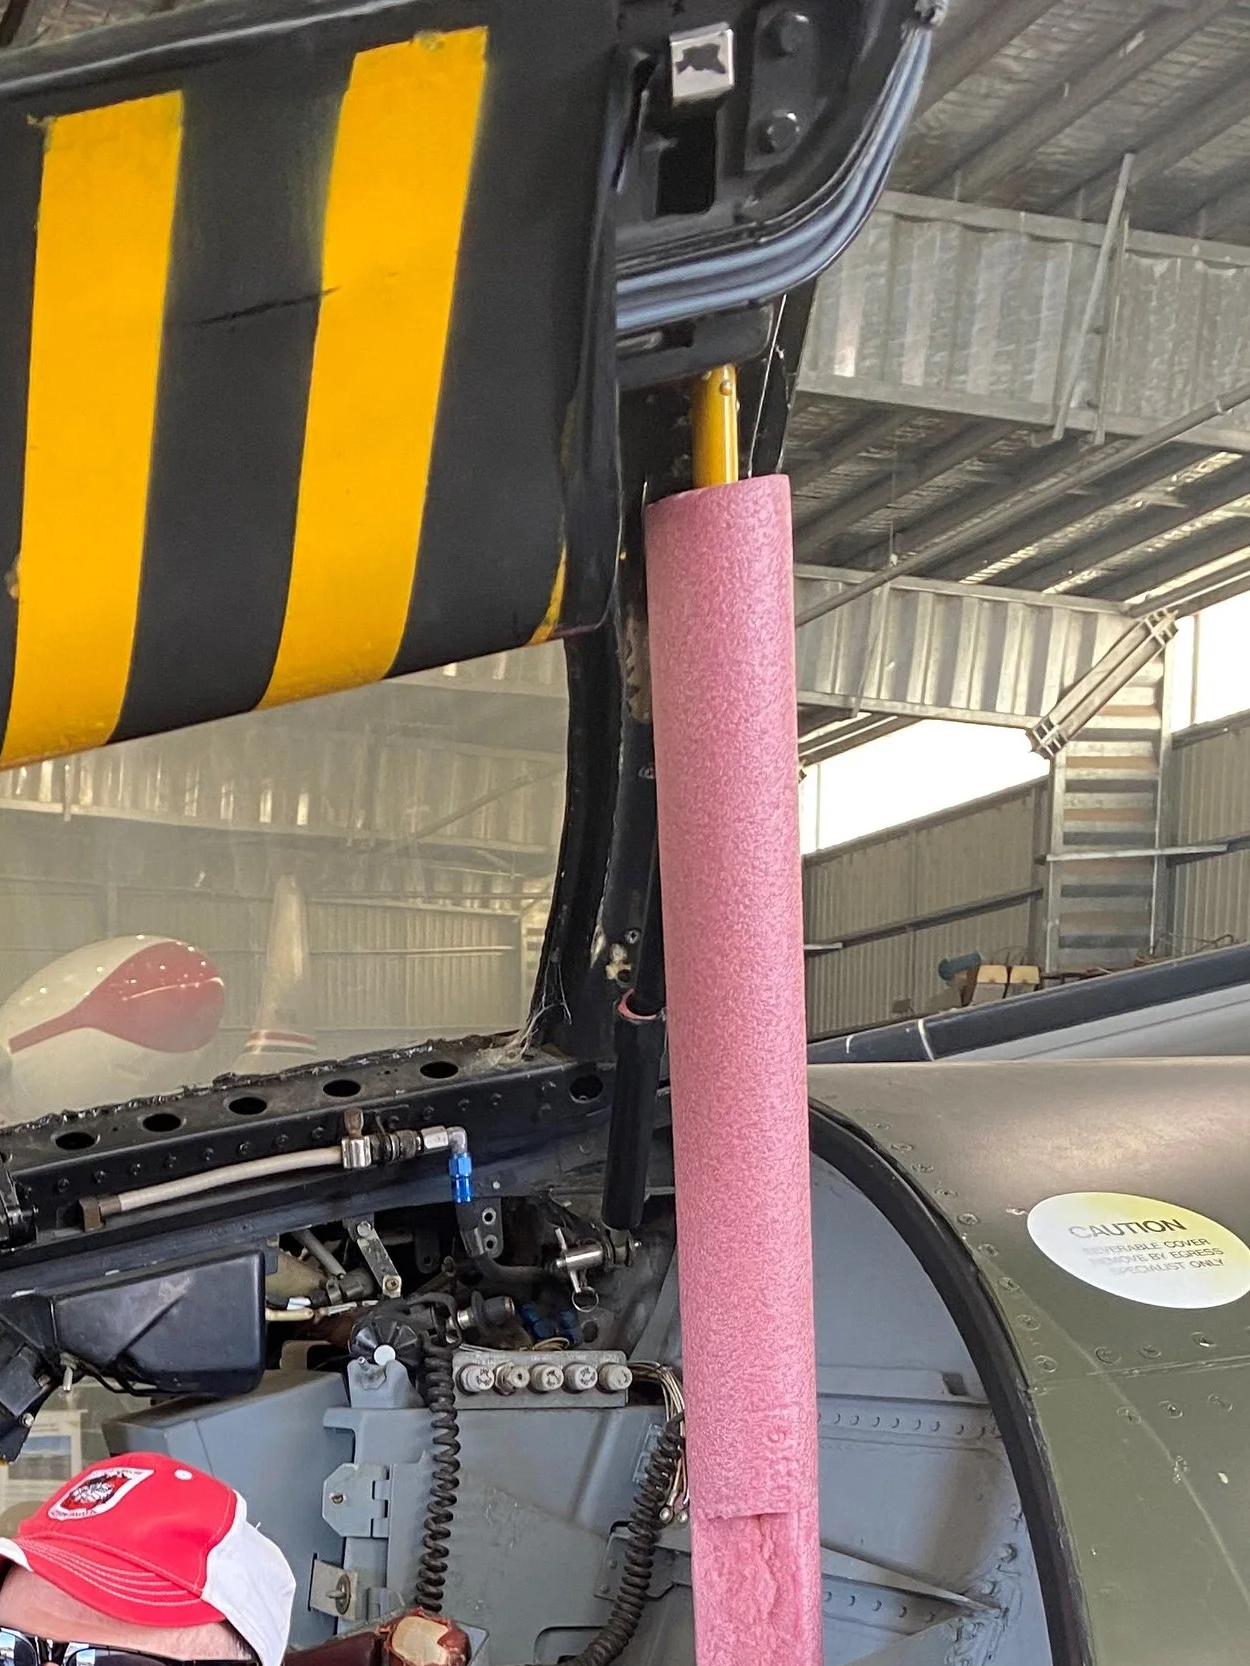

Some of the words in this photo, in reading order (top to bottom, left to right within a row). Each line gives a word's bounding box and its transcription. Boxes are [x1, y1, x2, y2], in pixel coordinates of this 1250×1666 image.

[1069, 1218, 1188, 1239] CAUTION
[1164, 1238, 1211, 1249] COVER
[1150, 1251, 1166, 1261] BY
[1171, 1247, 1225, 1259] EGRESS
[1109, 1262, 1186, 1275] SPECIALIST
[1189, 1258, 1226, 1269] ONLY
